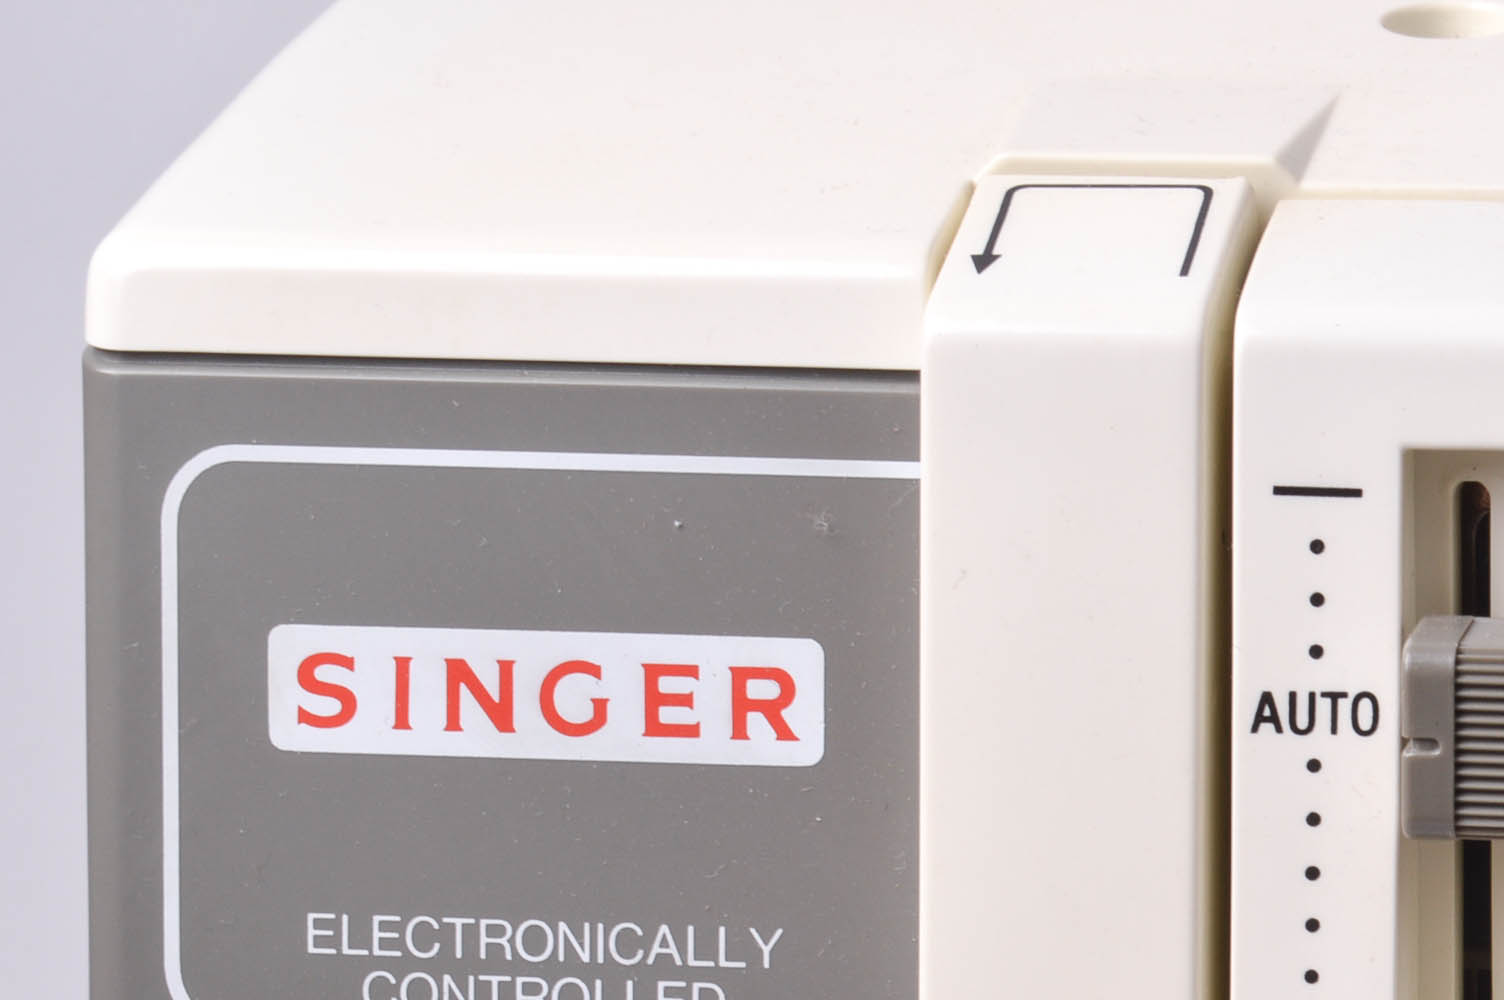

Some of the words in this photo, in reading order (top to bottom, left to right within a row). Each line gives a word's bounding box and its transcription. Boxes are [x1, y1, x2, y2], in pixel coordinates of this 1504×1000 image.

[295, 651, 800, 742] SINGER
[1250, 690, 1380, 737] AUTO
[306, 912, 784, 967] ELECTRONICALLY
